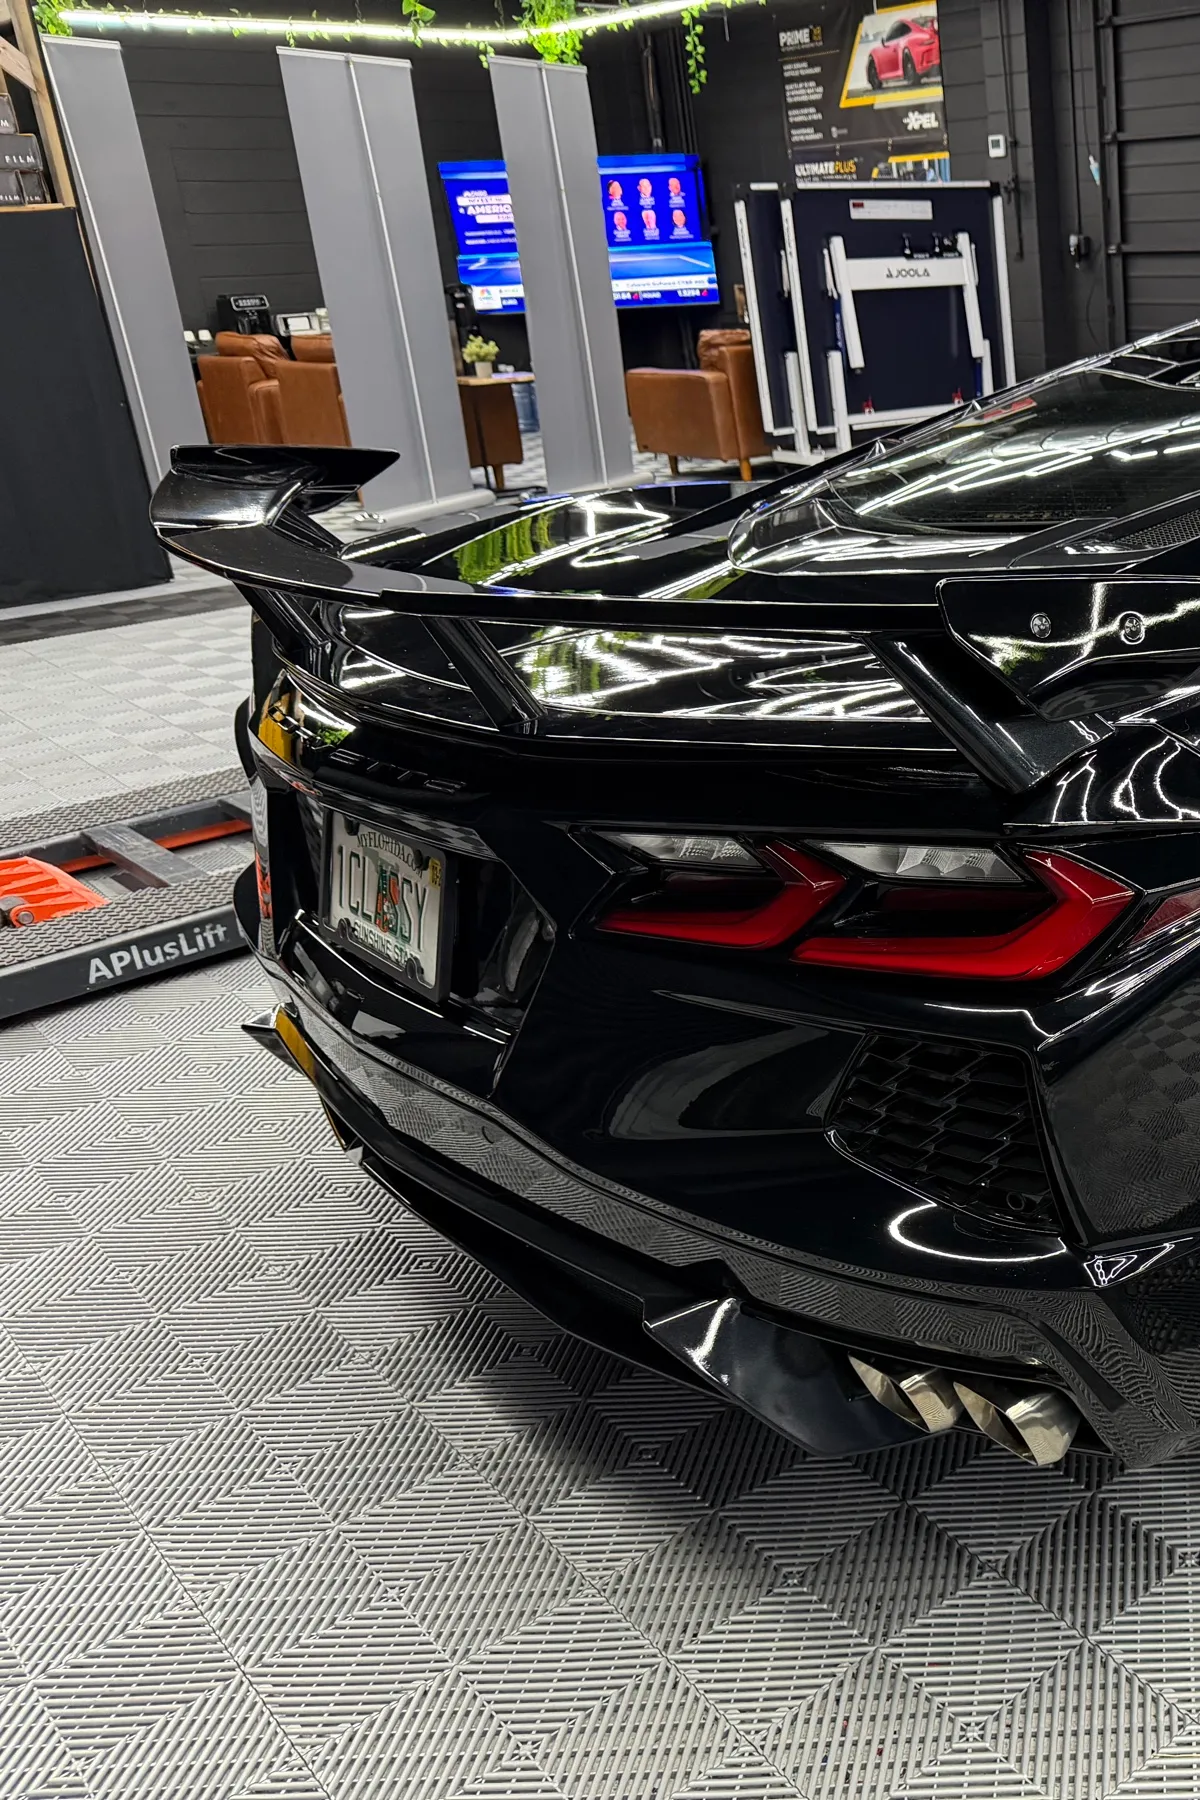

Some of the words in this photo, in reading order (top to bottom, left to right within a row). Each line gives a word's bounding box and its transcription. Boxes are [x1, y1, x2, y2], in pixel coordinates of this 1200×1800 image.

[779, 28, 810, 47] PRIME
[907, 111, 939, 131] XPEL
[5, 155, 35, 163] FILM
[895, 268, 931, 279] JOOLA
[337, 845, 430, 952] 1CLASSY
[353, 919, 393, 960] SUNSHINE
[88, 923, 228, 984] APlusLift
